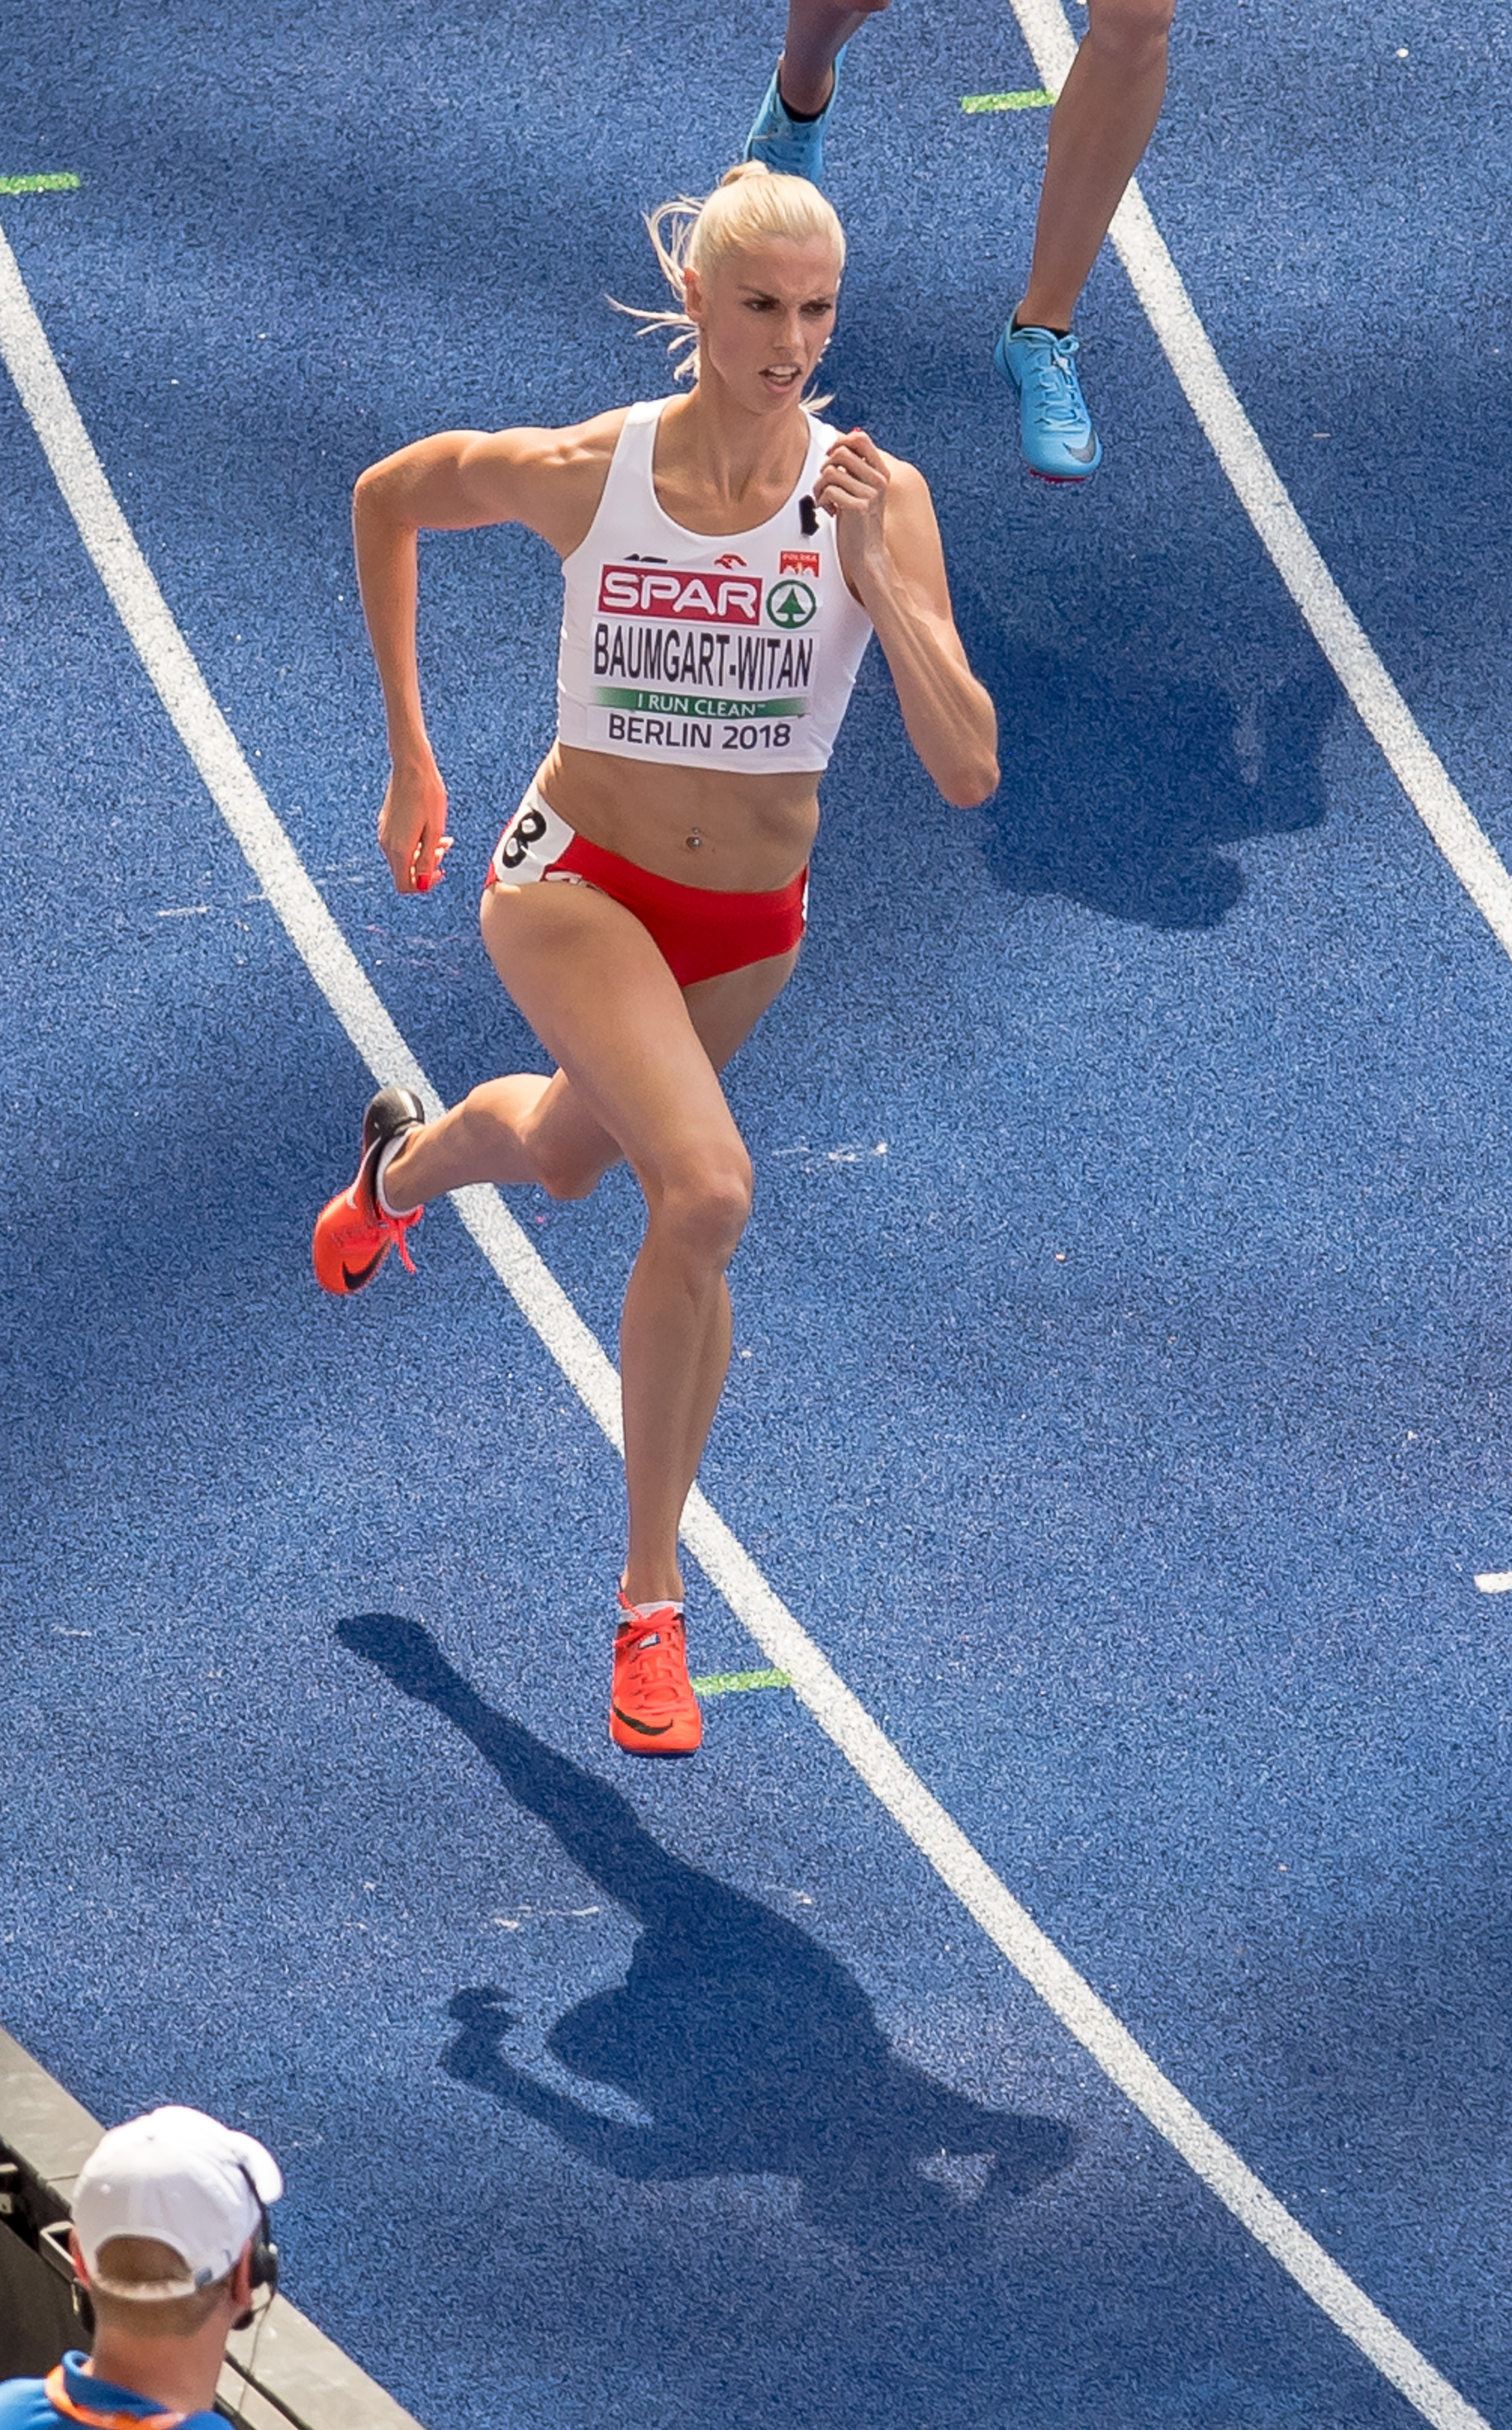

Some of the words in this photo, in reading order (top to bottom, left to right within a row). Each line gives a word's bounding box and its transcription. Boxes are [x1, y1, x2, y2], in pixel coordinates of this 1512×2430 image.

[602, 572, 756, 619] SPAR
[594, 623, 813, 691] BAUMGART-WITAN
[637, 695, 643, 708] I
[648, 697, 689, 713] RUN
[609, 714, 712, 748] BERLIN
[722, 723, 791, 750] 2018
[502, 809, 547, 868] 8
